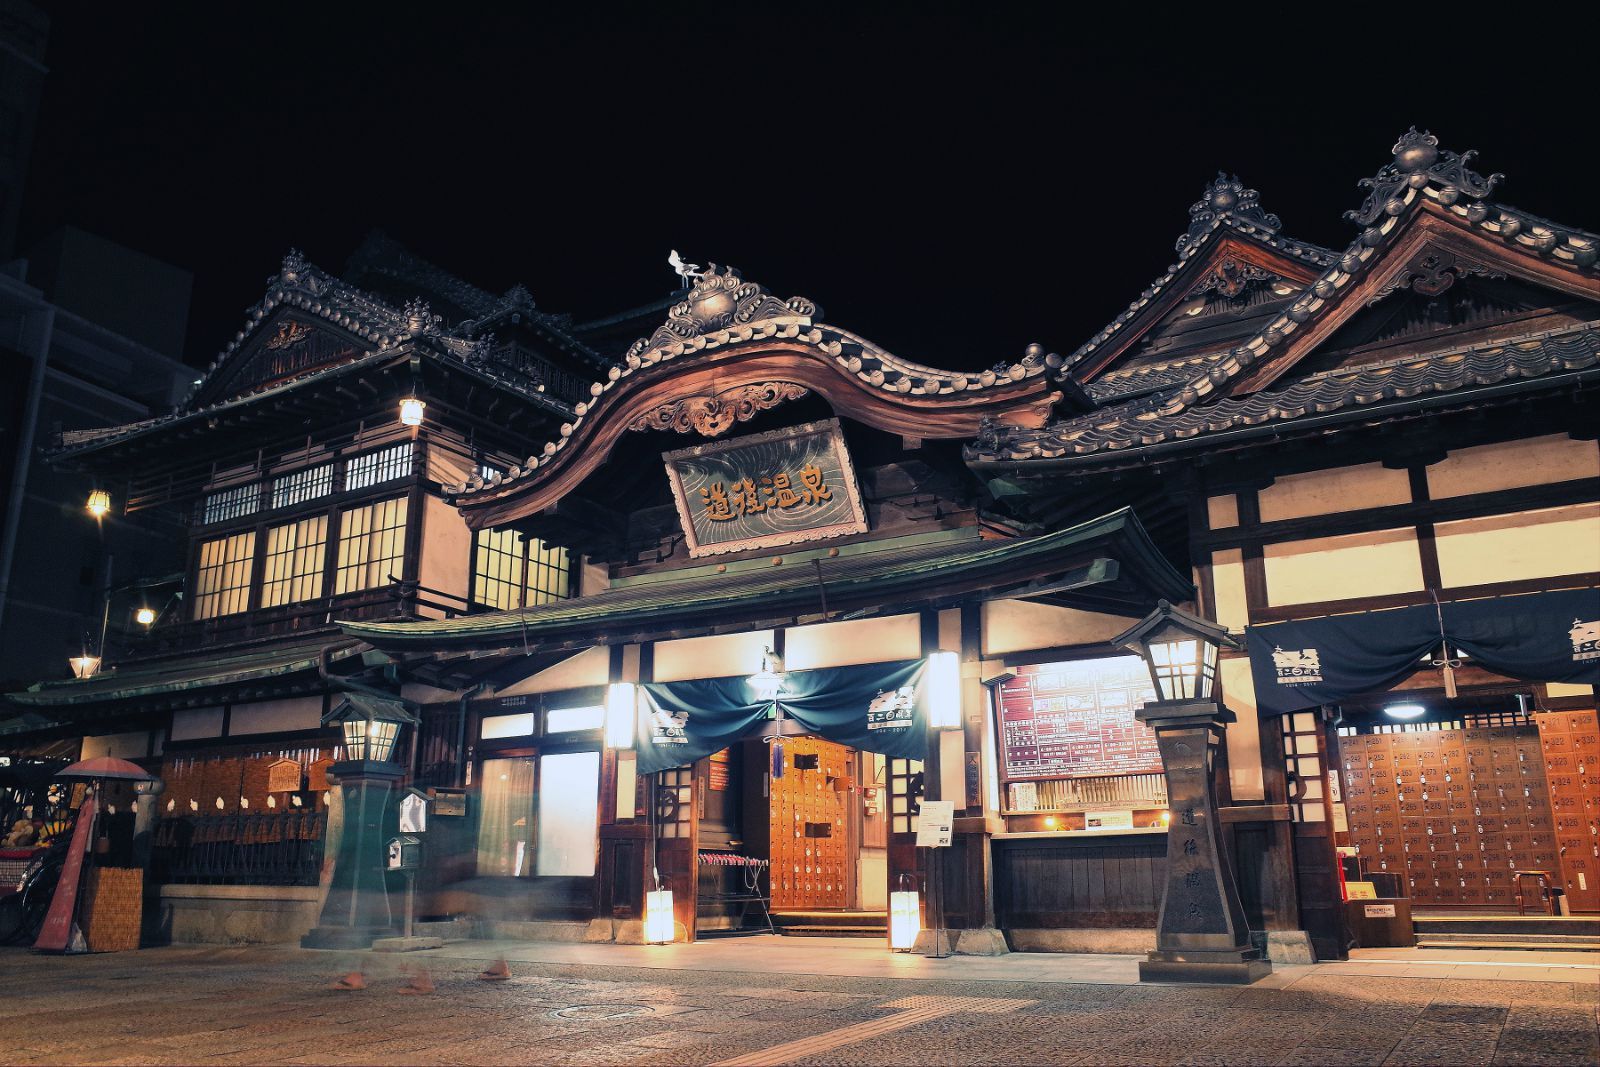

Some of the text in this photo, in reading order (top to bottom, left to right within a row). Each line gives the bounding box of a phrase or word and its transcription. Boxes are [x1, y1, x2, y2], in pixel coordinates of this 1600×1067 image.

[699, 463, 832, 522] 道後温泉
[1552, 738, 1564, 746] 322
[1580, 736, 1596, 744] 330
[1557, 777, 1570, 786] 324
[1560, 797, 1574, 806] 325
[1564, 818, 1578, 826] 326
[1571, 860, 1586, 868] 328
